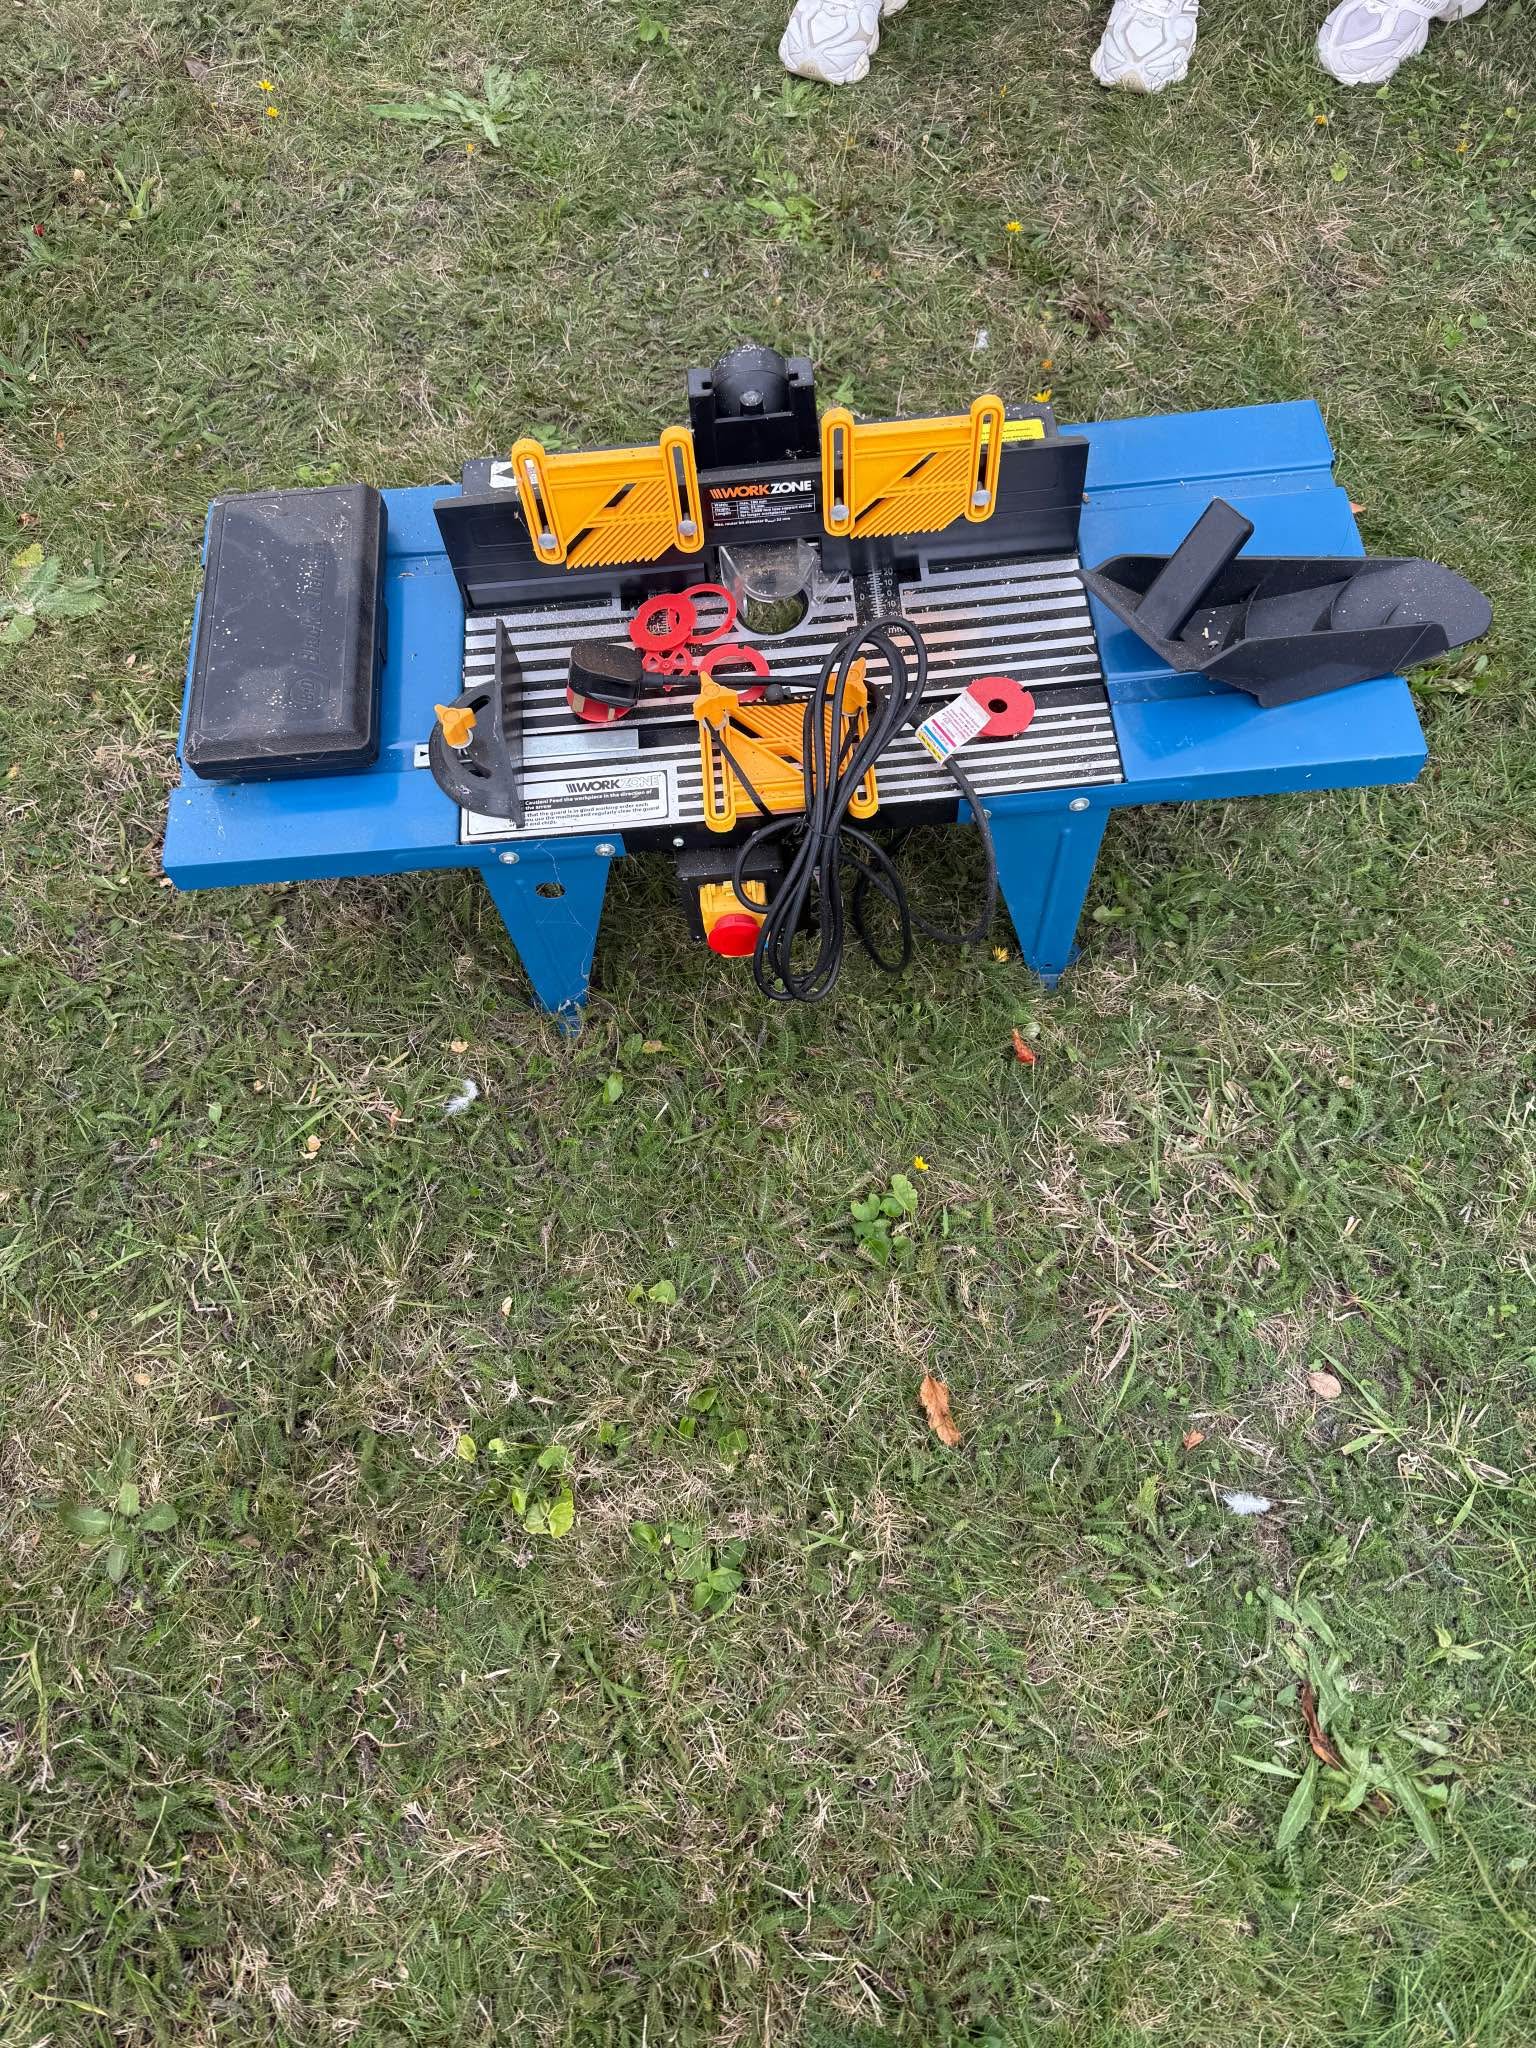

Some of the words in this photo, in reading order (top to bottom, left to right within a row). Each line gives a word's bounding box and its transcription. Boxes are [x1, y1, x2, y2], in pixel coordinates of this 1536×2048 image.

[710, 480, 812, 498] WORKZONE
[859, 593, 865, 601] 0
[886, 589, 892, 597] 0
[887, 600, 897, 608] 10
[574, 793, 602, 801] workpiece
[620, 789, 646, 797] direction
[595, 804, 618, 812] working
